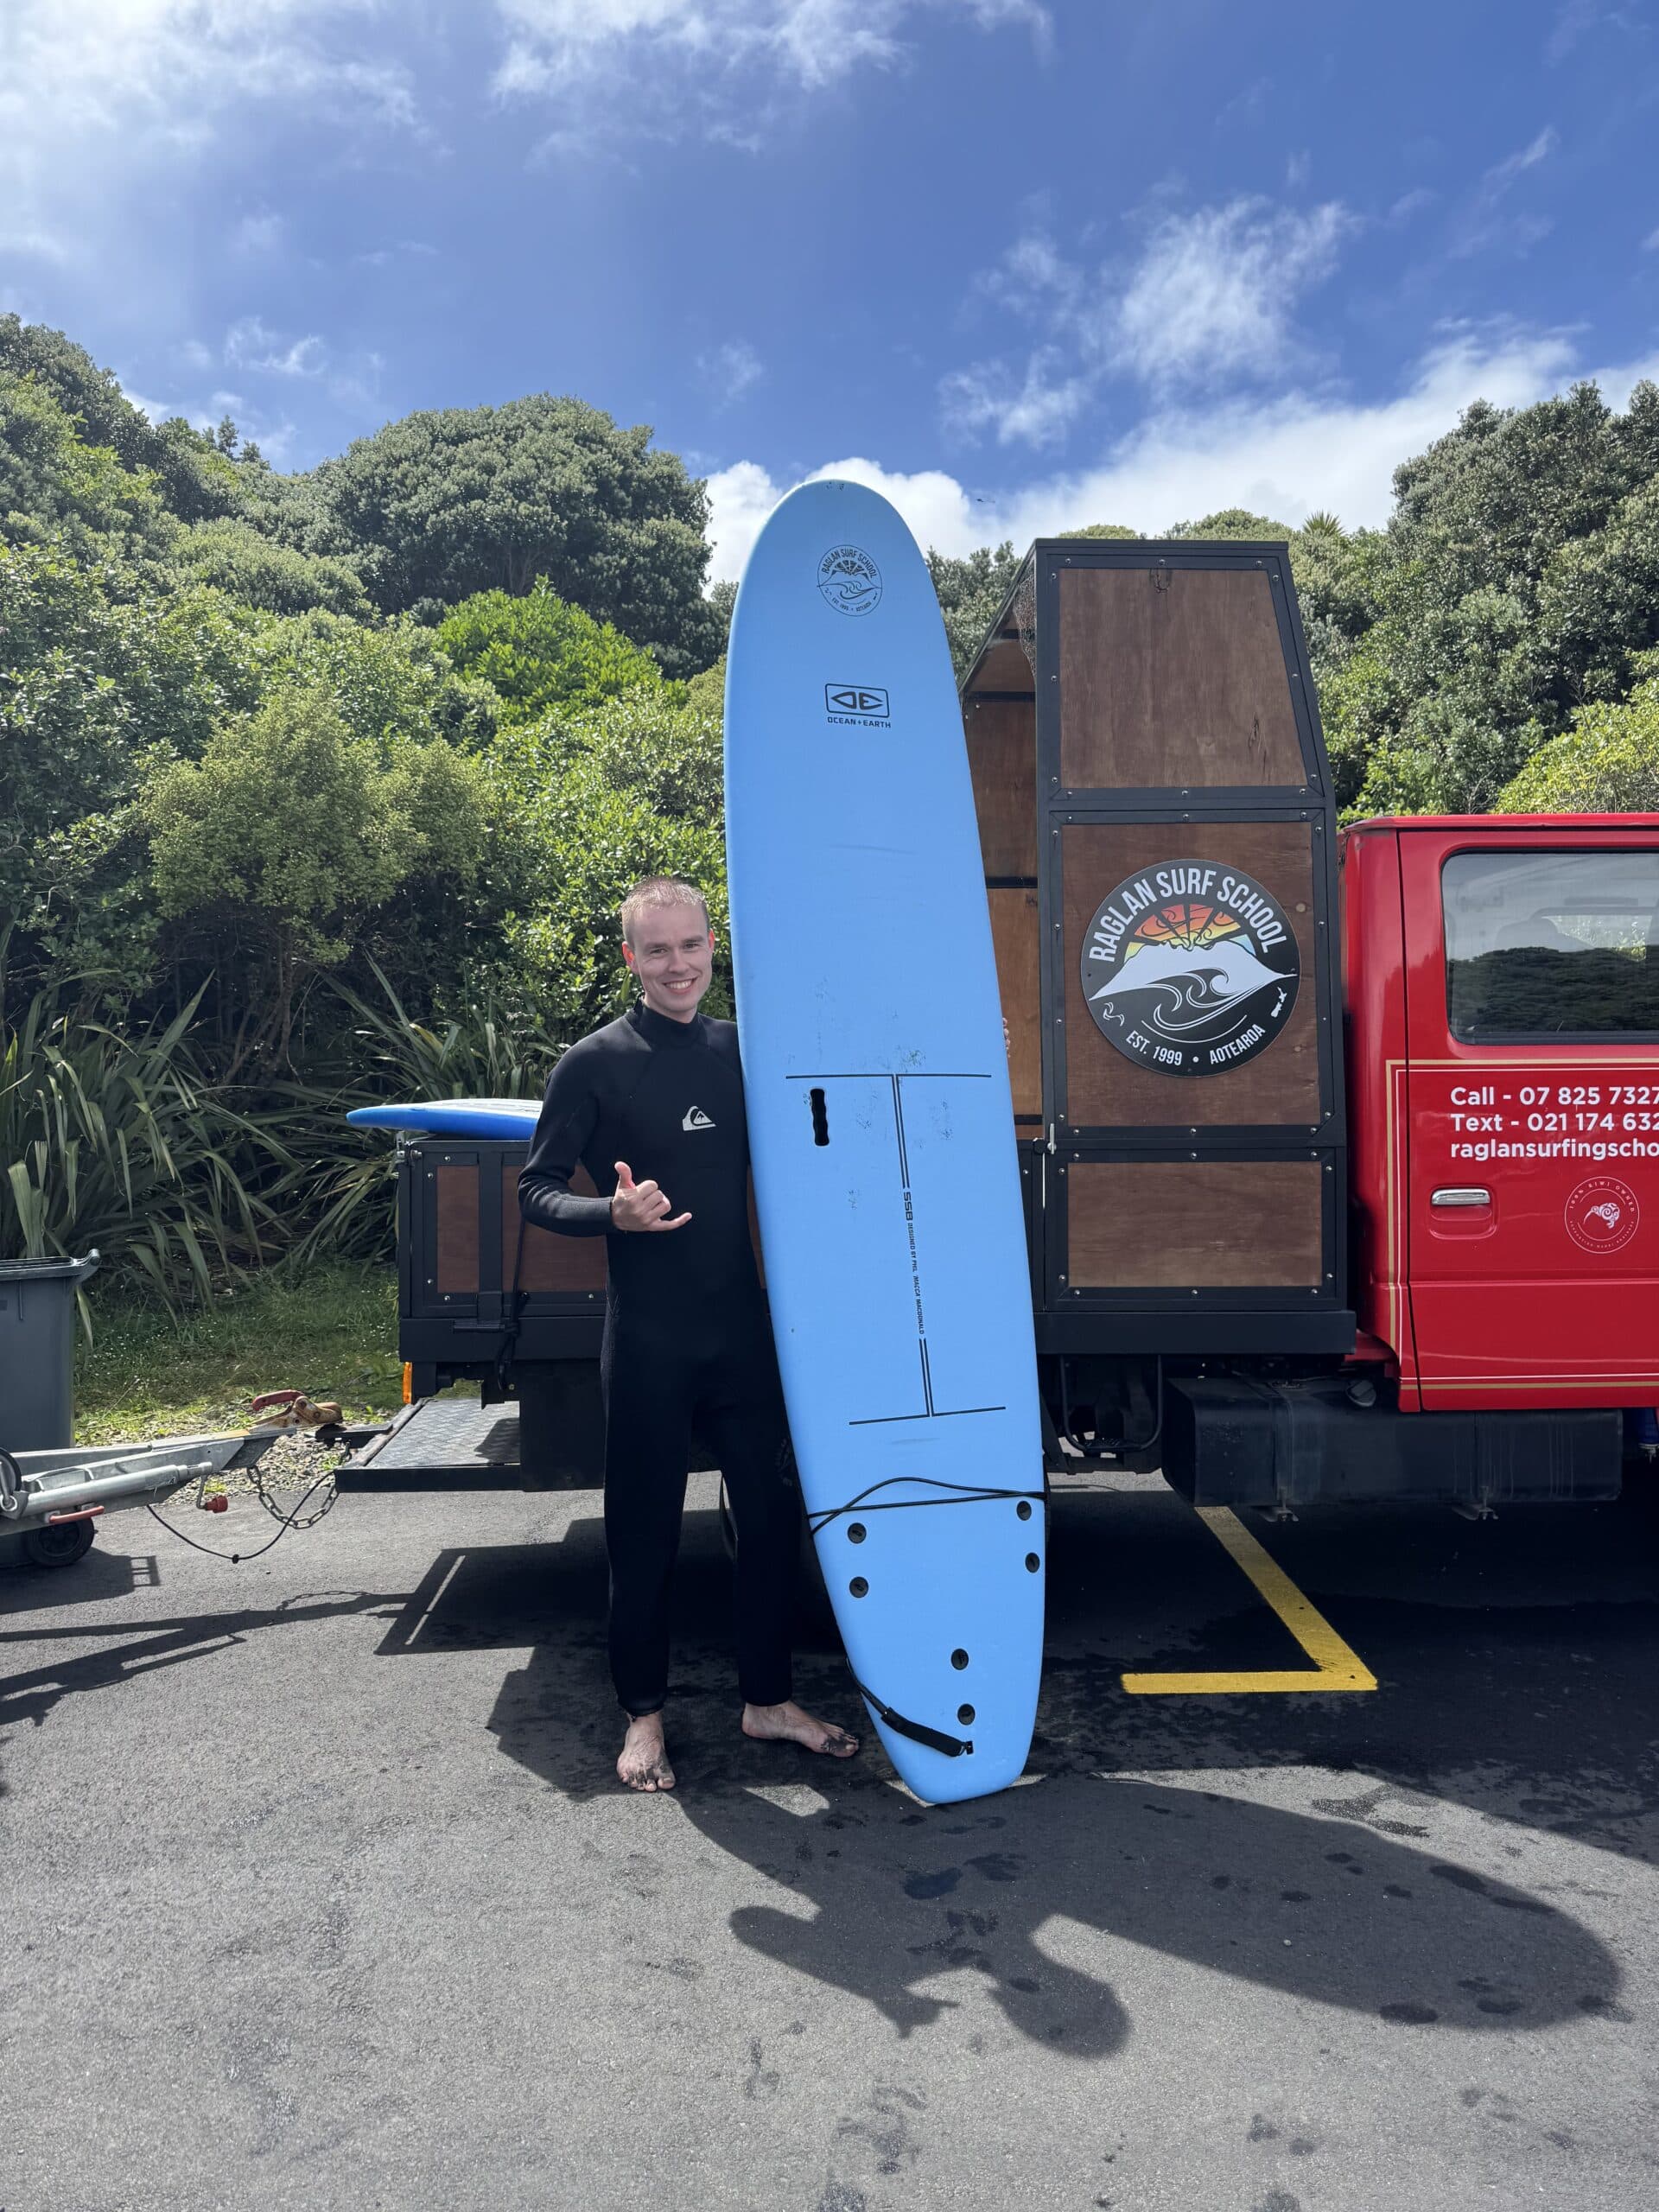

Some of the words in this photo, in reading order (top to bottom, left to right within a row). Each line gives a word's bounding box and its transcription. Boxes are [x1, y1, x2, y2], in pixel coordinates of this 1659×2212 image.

[821, 550, 841, 575] RAGLAN
[841, 548, 858, 558] SURF
[858, 553, 878, 579] SCHOOL
[827, 716, 856, 726] OCEAN
[862, 720, 891, 728] EARTH
[1089, 878, 1158, 963] RAGLAN
[1155, 868, 1217, 898] SURF
[1217, 876, 1287, 954] SCHOOL
[1125, 1030, 1150, 1055] EST.
[1152, 1046, 1182, 1066] 1999
[1209, 1023, 1266, 1065] AOTEAROA
[1450, 1086, 1495, 1105] Call
[1519, 1087, 1550, 1105] 07
[1558, 1087, 1601, 1105] 825
[1450, 1113, 1503, 1132] Text
[1527, 1114, 1567, 1132] 021
[1575, 1113, 1614, 1132] 174
[904, 1192, 913, 1221] SSB
[912, 1275, 921, 1297] MACCA
